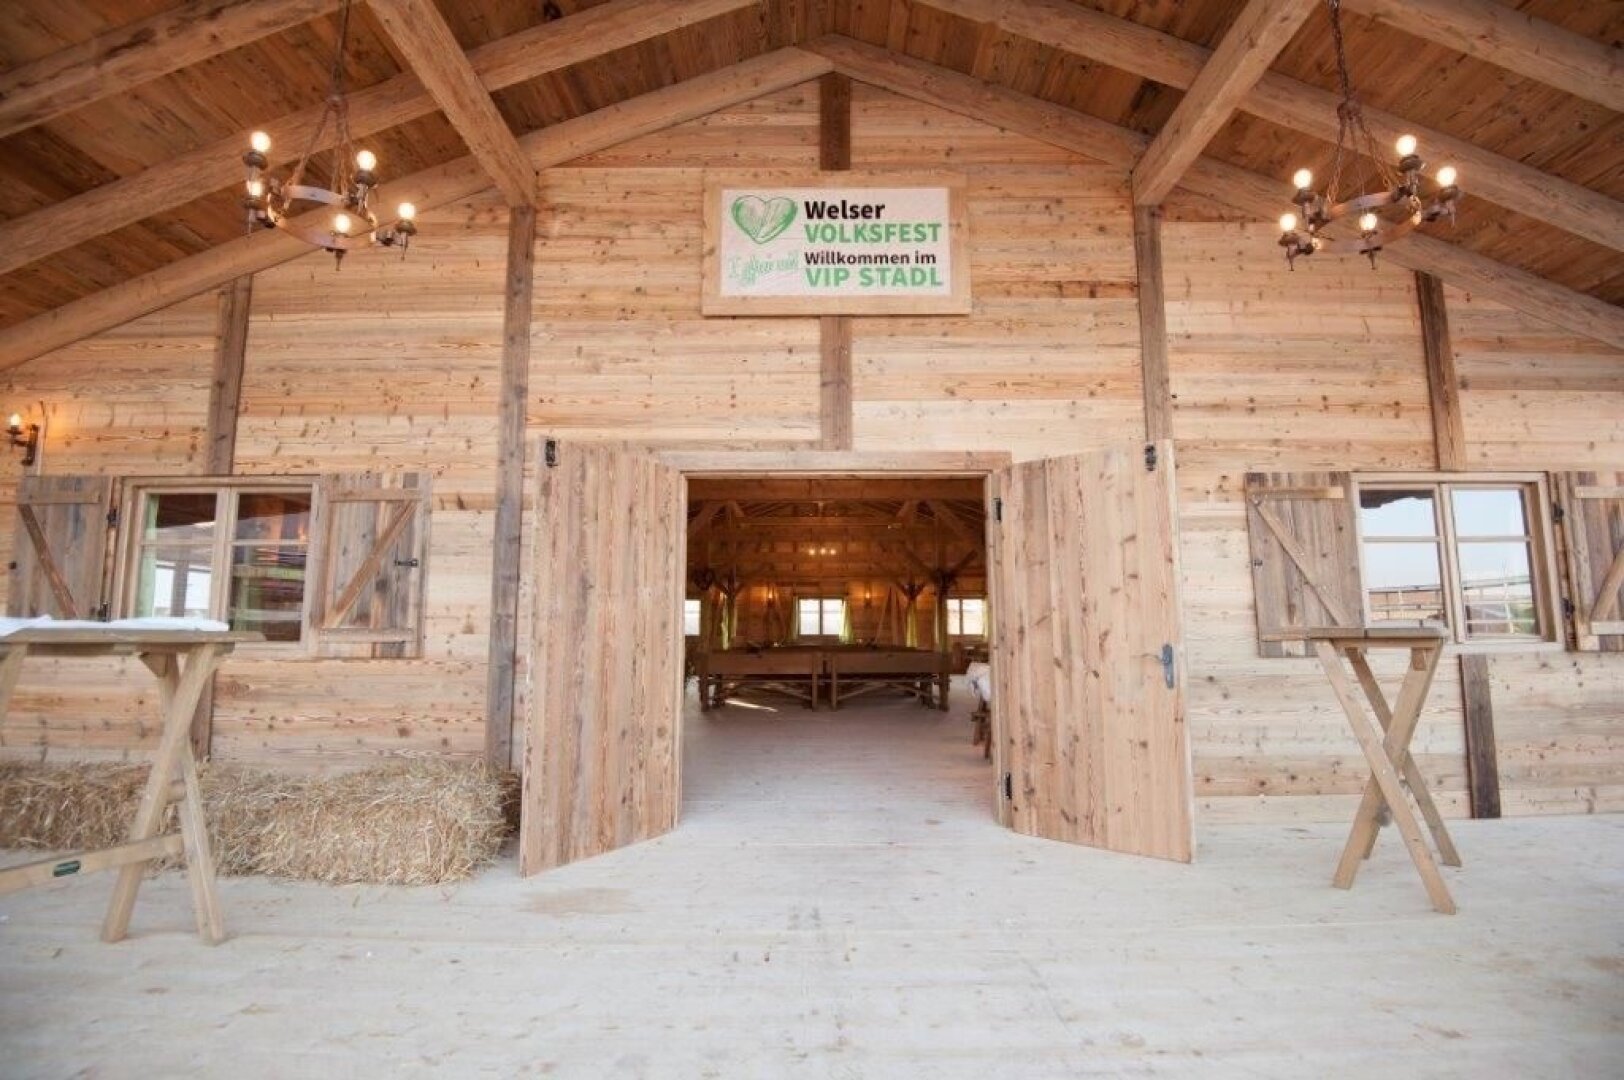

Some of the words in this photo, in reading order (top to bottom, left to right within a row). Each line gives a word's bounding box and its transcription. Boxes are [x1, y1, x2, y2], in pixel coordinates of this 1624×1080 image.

[805, 200, 885, 219] Welser
[805, 223, 942, 243] VOLKSFEST
[804, 251, 909, 265] Willkommen
[915, 251, 936, 265] im
[805, 268, 849, 287] VIP
[859, 268, 944, 287] STADL
